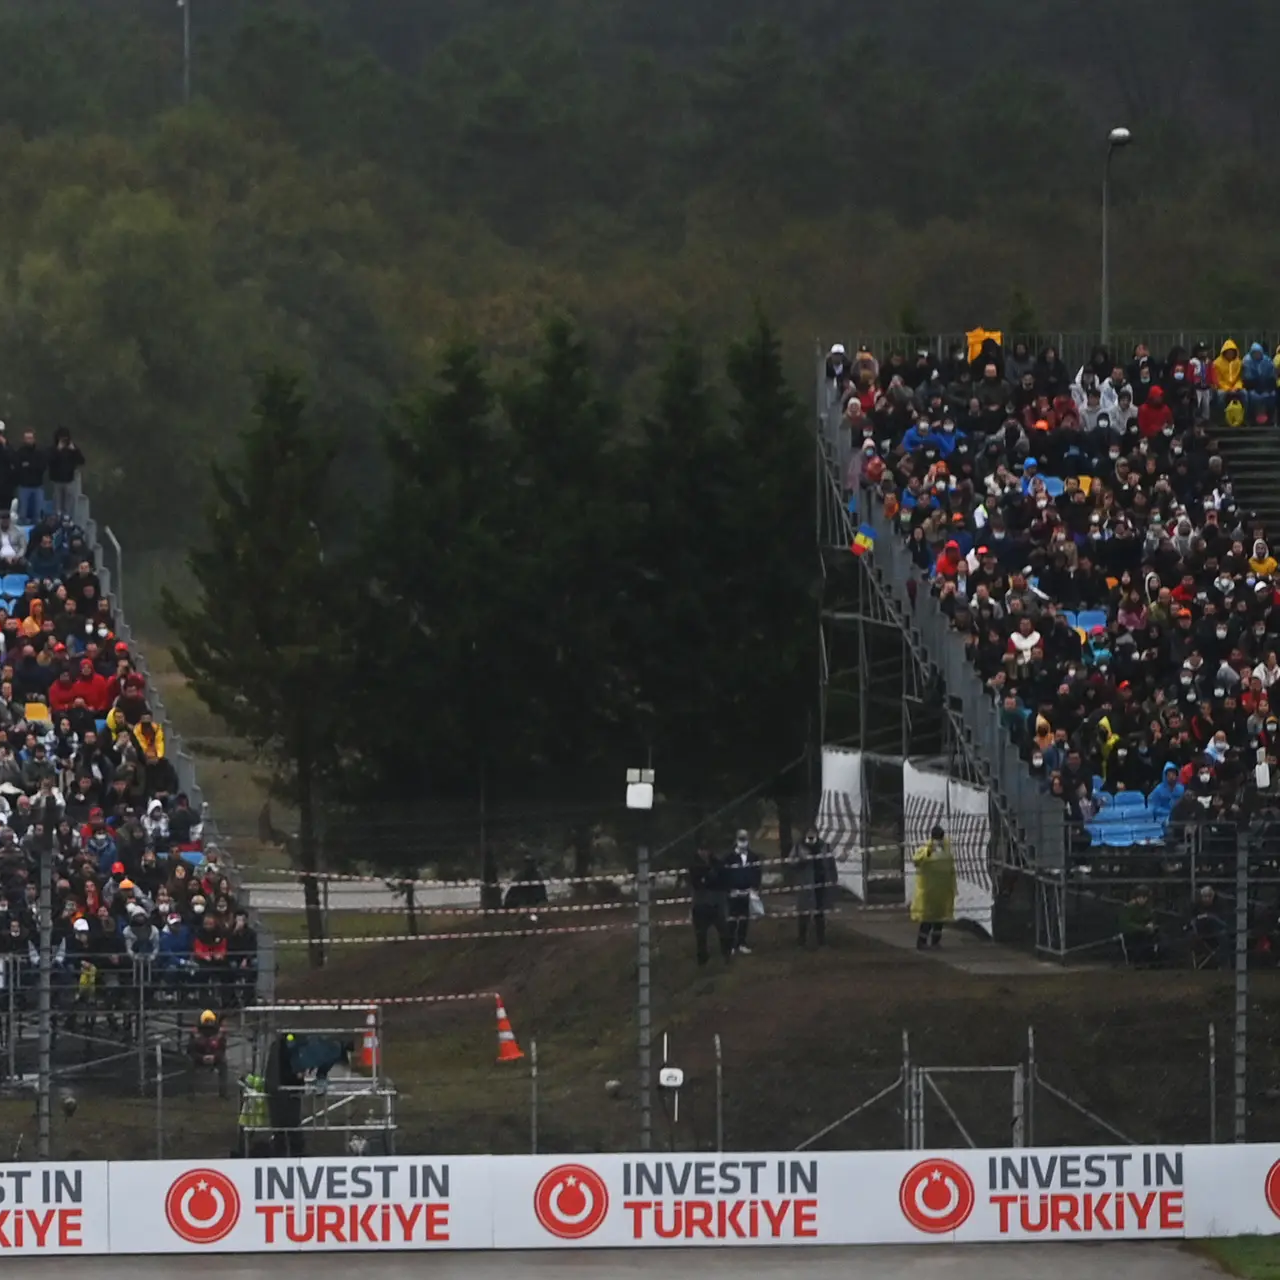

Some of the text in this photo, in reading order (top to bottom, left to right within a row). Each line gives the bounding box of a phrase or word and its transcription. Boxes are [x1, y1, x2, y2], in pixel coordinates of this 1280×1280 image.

[43, 1170, 82, 1203] IN
[255, 1165, 449, 1200] INVEST IN
[623, 1161, 817, 1195] INVEST IN
[989, 1153, 1183, 1190] INVEST IN
